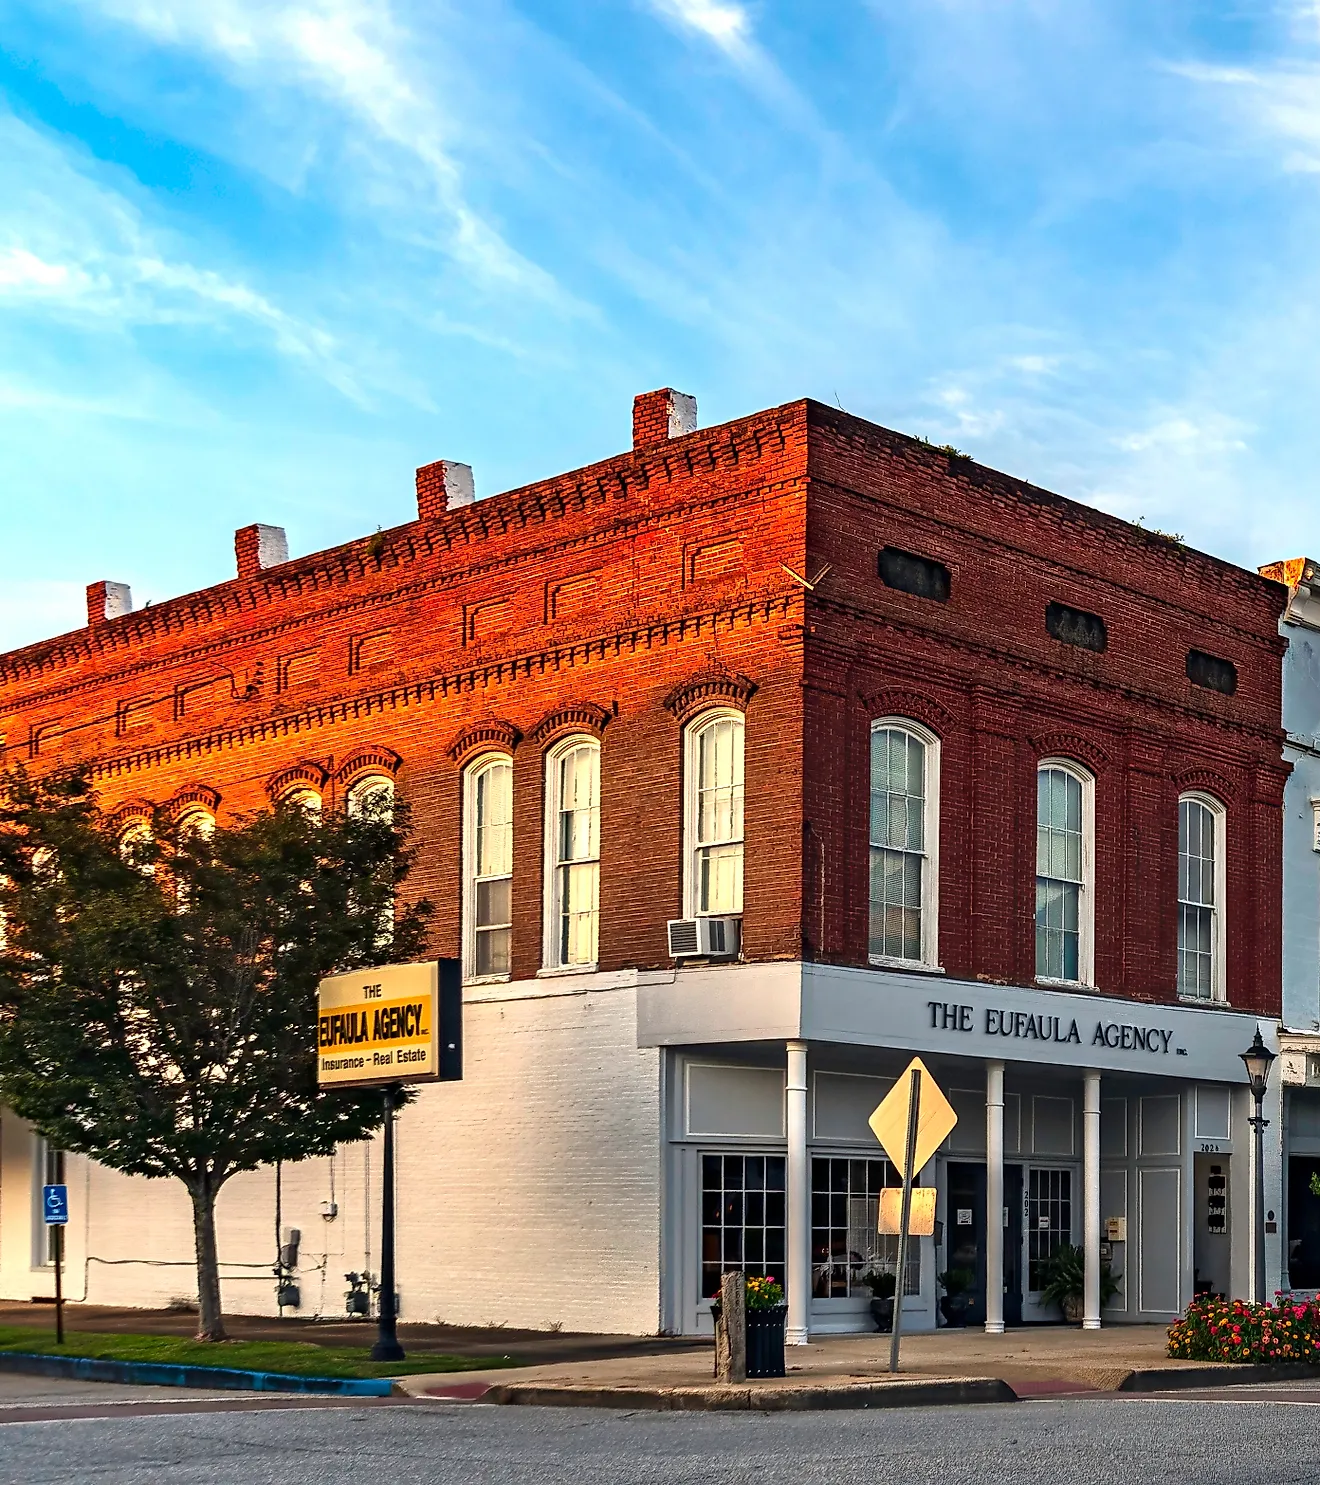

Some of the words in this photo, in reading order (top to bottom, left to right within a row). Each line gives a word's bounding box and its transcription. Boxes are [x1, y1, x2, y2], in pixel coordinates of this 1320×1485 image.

[363, 984, 382, 999] THE
[320, 1011, 369, 1047] EUFAULA
[373, 1004, 423, 1040] AGENCY
[927, 1001, 974, 1032] THE
[985, 1008, 1082, 1044] EUFAULA
[1091, 1021, 1174, 1054] AGENCY
[321, 1057, 365, 1071] Insurance
[373, 1051, 393, 1066] Real
[397, 1048, 427, 1064] Estate
